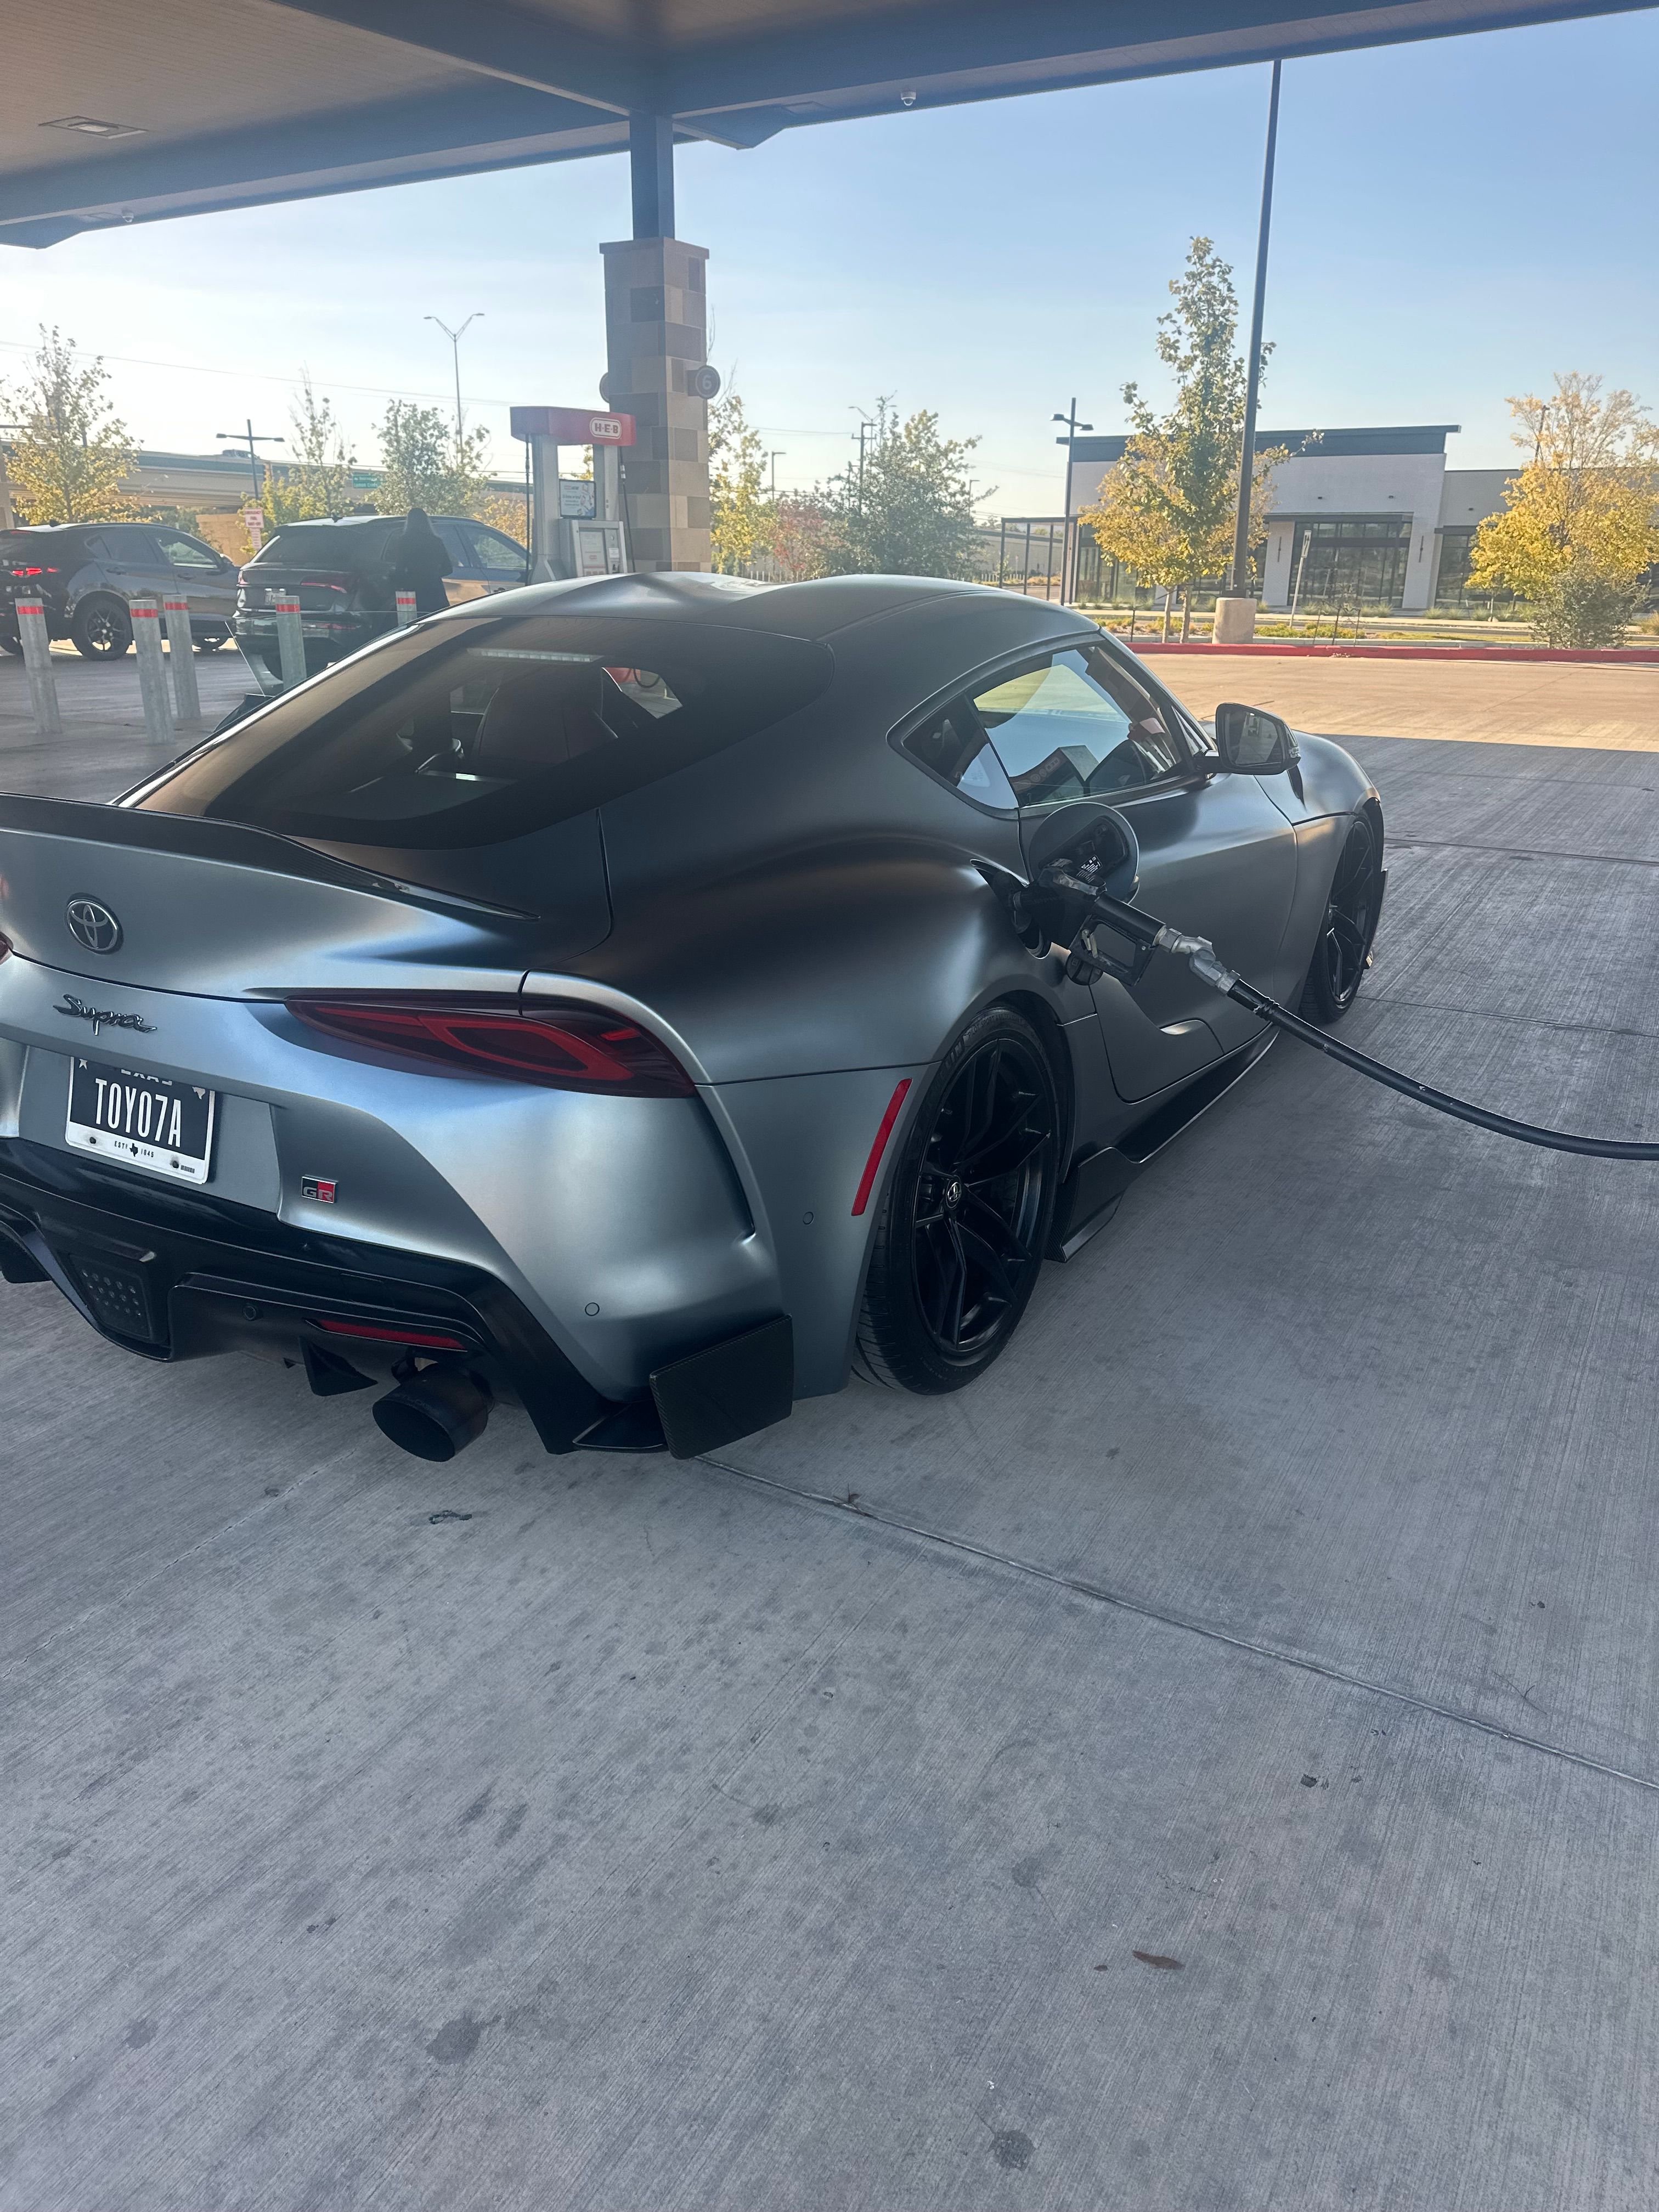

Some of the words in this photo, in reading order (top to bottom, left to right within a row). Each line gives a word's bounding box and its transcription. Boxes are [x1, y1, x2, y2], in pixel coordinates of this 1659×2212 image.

[702, 374, 712, 390] 6
[53, 994, 157, 1036] Supra
[140, 1148, 154, 1158] 1845
[303, 1186, 333, 1202] GR
